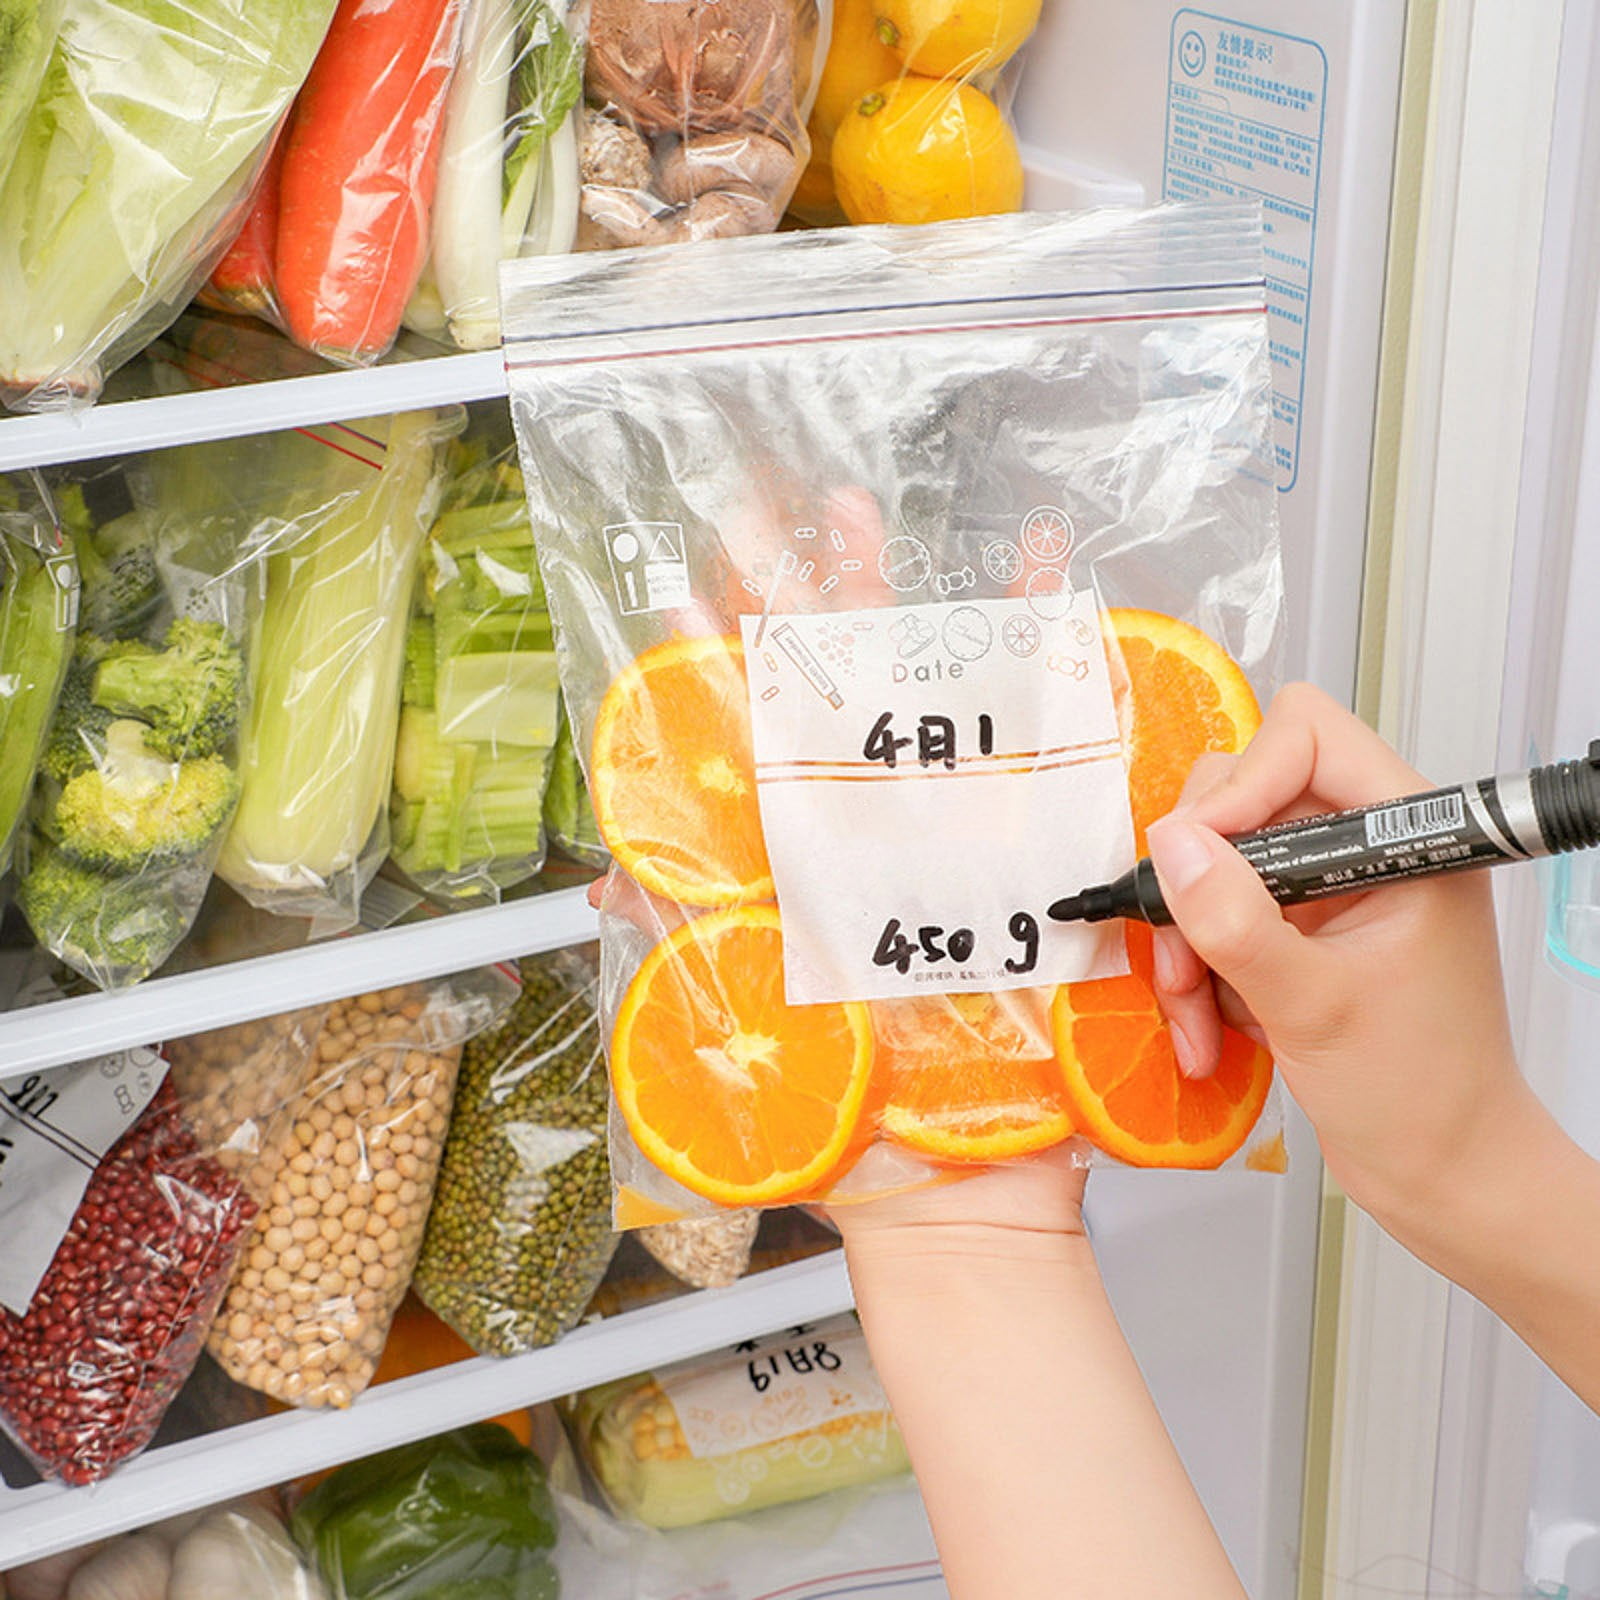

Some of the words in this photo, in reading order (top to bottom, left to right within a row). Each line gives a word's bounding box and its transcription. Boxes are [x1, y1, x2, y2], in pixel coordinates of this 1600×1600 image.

[892, 662, 964, 683] Date
[1384, 843, 1413, 857] MADE
[1413, 840, 1425, 851] IN
[1425, 834, 1459, 849] CHINA
[872, 918, 975, 975] 450
